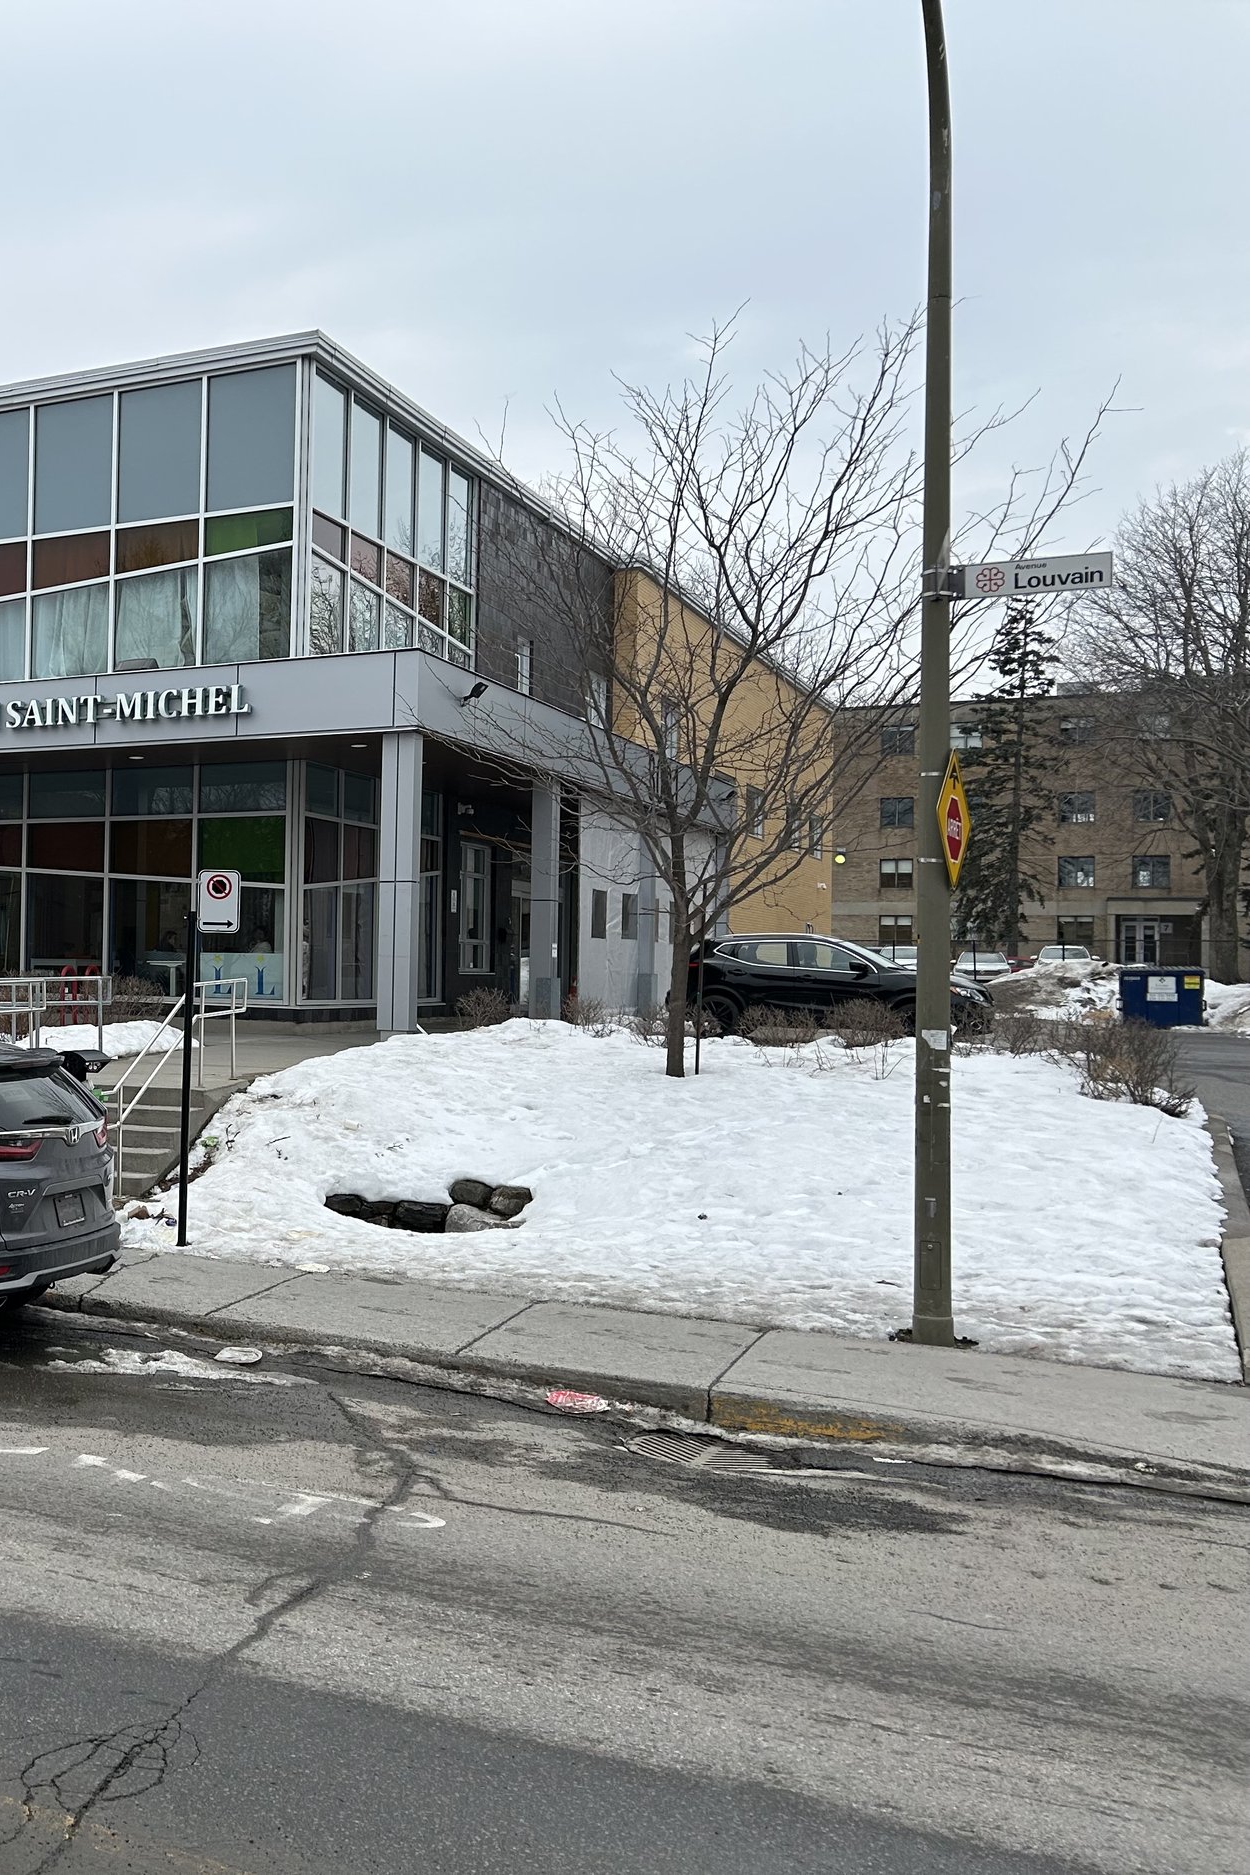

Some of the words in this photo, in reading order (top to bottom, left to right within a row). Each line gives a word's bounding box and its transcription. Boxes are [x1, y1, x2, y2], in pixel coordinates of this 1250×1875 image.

[1014, 562, 1047, 570] Avenue
[1014, 567, 1103, 589] Louvain
[5, 683, 250, 729] SAINT-MICHEL
[7, 1188, 36, 1199] CR-V
